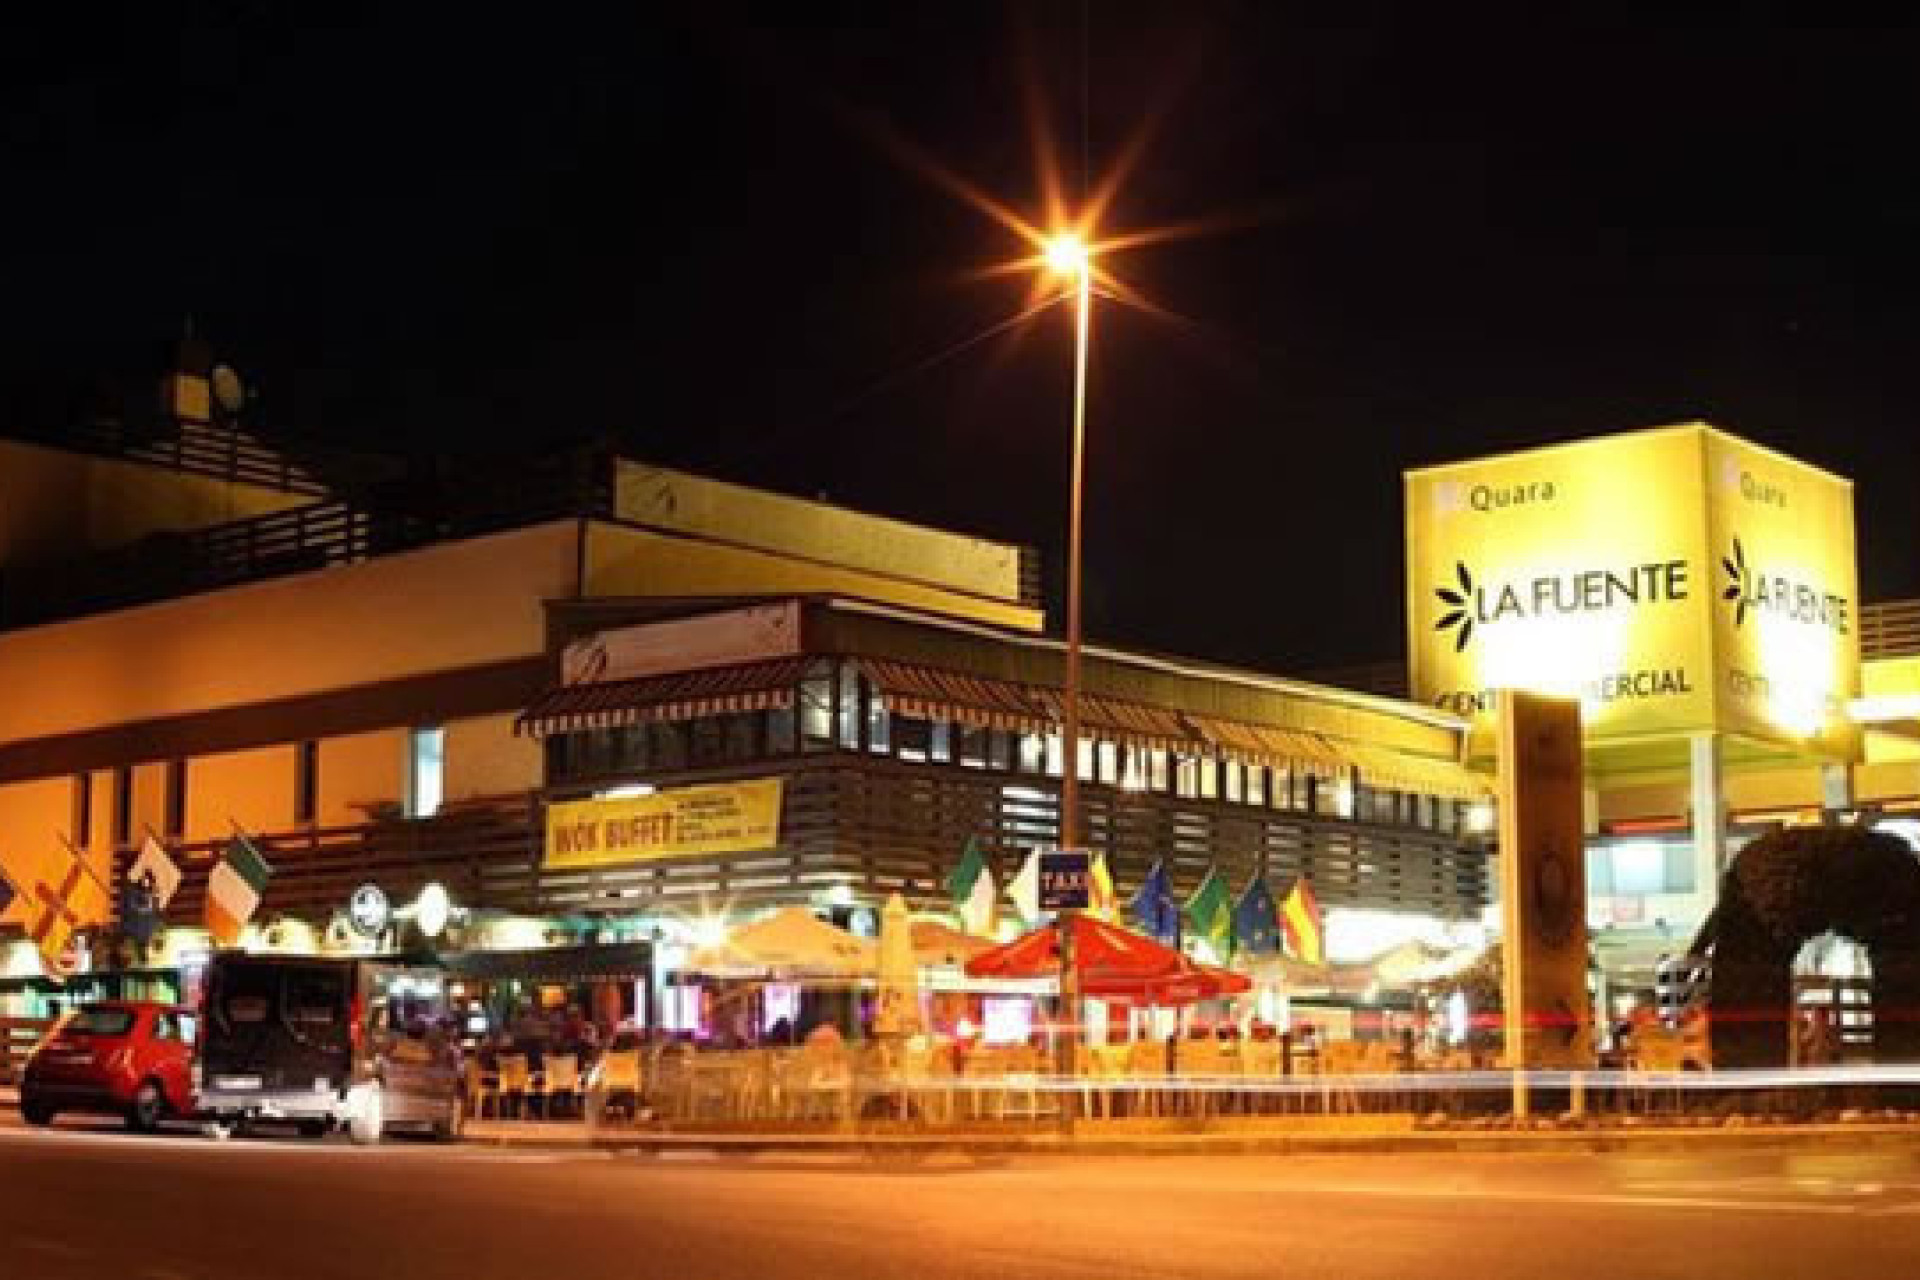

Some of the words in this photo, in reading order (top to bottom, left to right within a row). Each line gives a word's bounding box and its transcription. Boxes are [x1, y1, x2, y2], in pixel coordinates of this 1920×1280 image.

[1470, 480, 1556, 511] Quara
[1476, 585, 1524, 624] LA
[1532, 560, 1688, 615] FUENTE
[1592, 667, 1693, 702] ERCIAL
